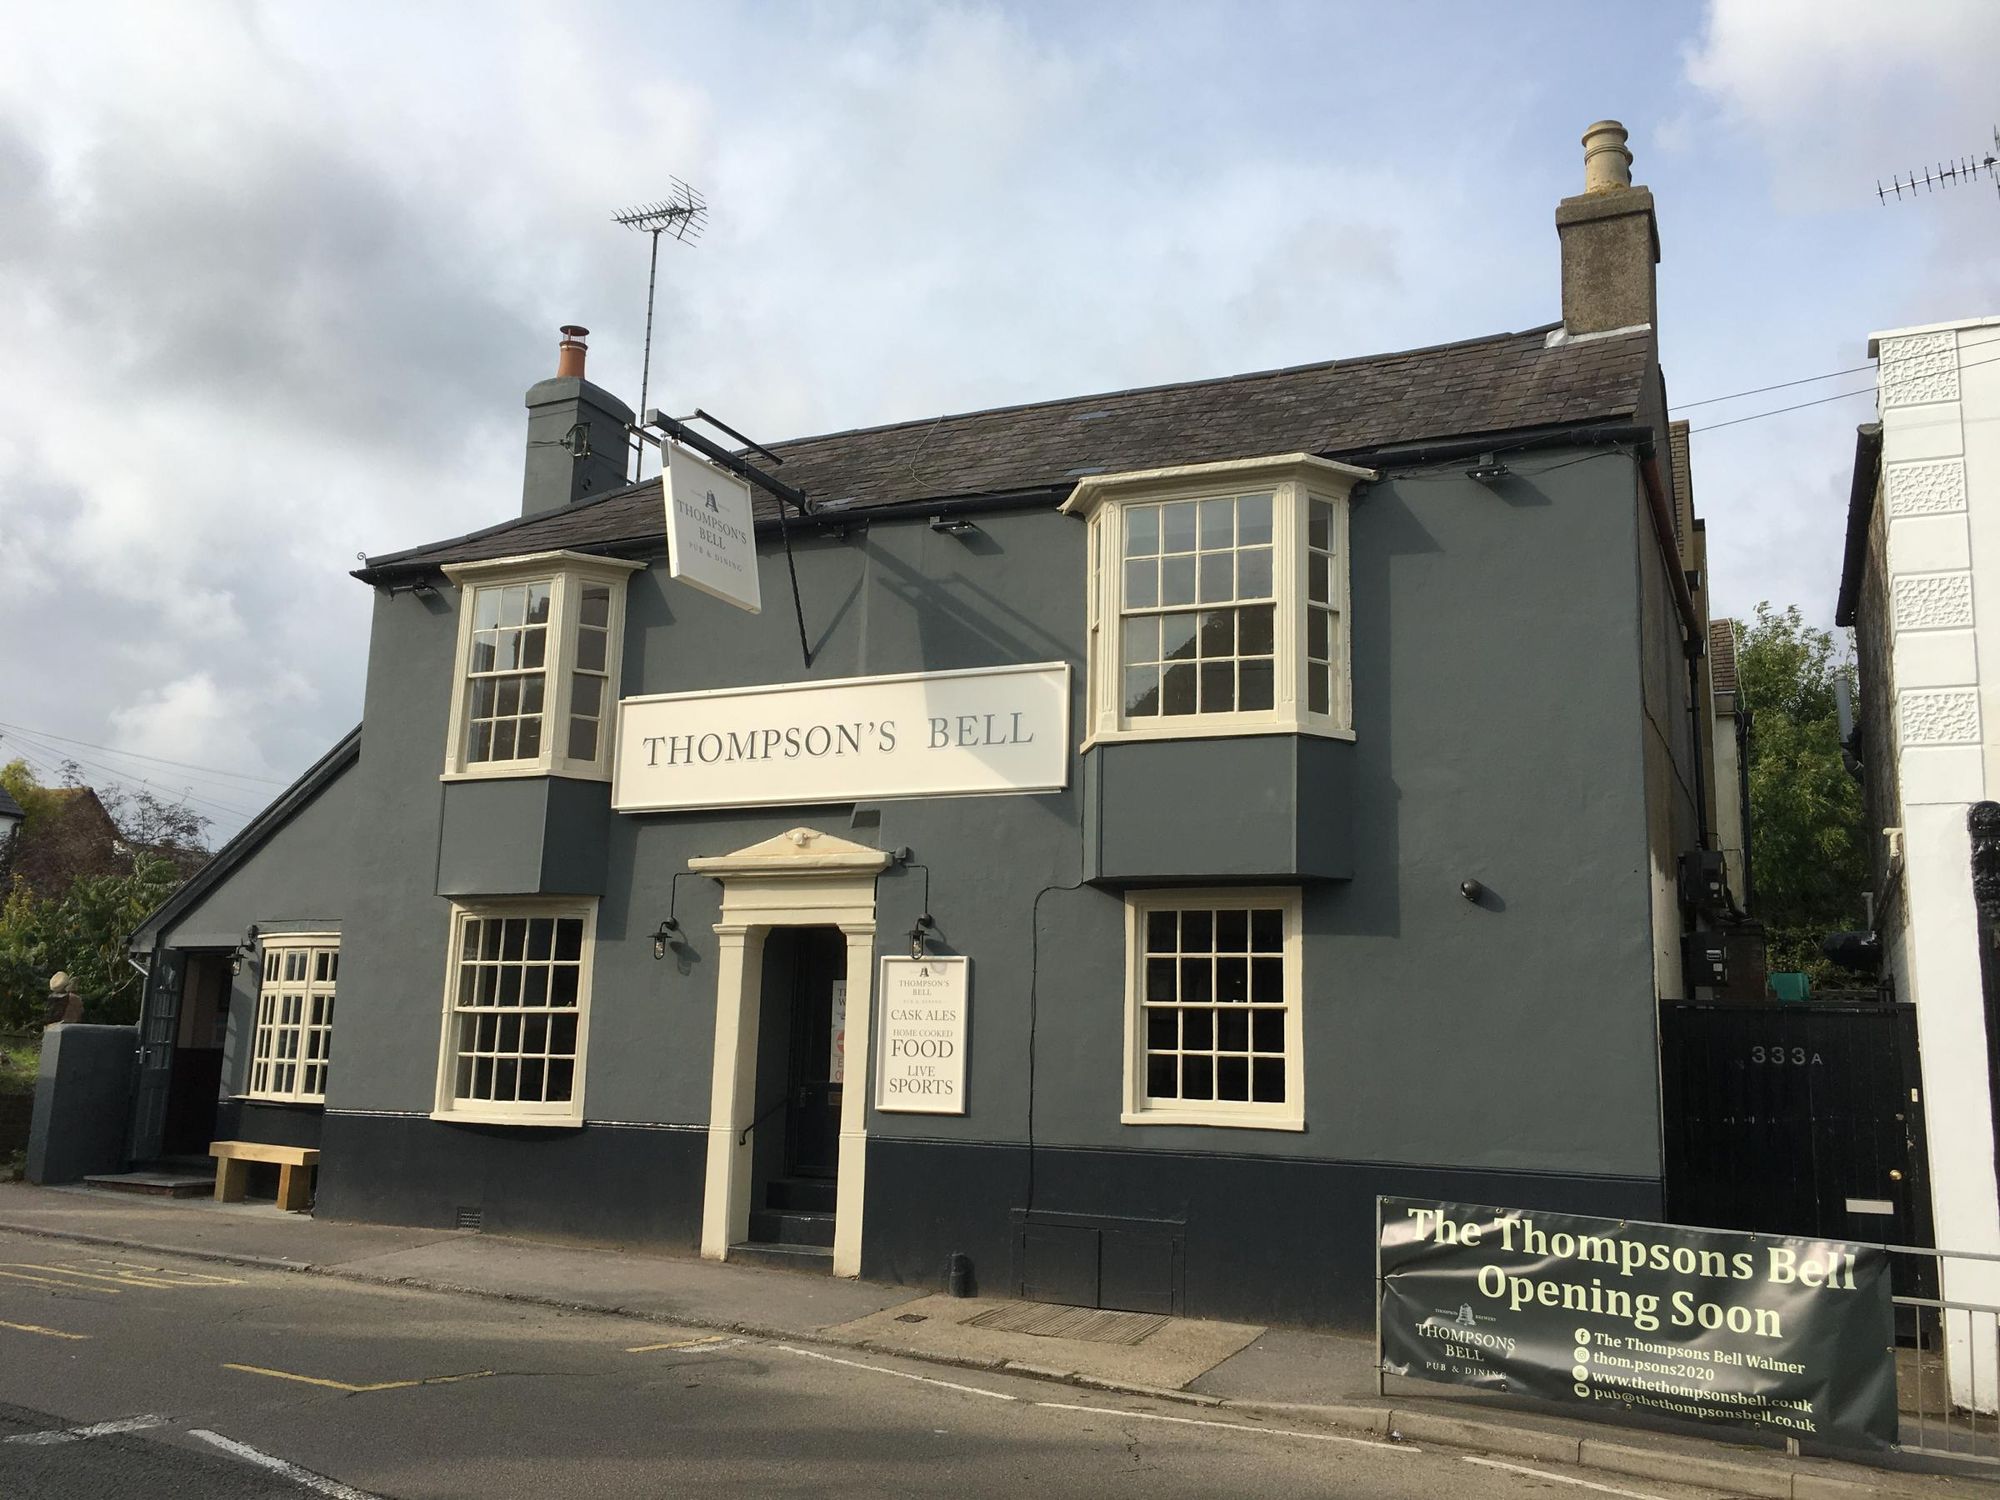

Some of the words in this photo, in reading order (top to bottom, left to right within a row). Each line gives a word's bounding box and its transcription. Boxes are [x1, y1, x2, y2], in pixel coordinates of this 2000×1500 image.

[676, 499, 747, 544] THOMPSON'S
[699, 527, 725, 550] BELL
[927, 712, 1034, 749] BELL
[891, 1009, 922, 1021] CASK
[925, 1010, 956, 1021] ALES
[893, 1029, 918, 1037] HOME
[919, 1029, 953, 1038] COOKED
[891, 1039, 954, 1058] FOOD
[908, 1065, 935, 1077] LIVE
[889, 1078, 953, 1095] SPORTS
[1408, 1207, 1482, 1247] The
[1494, 1216, 1753, 1279] Thompsons
[1767, 1247, 1858, 1290] Bell
[1477, 1265, 1660, 1331] Opening
[1671, 1290, 1784, 1338] Soon
[1415, 1323, 1516, 1351] THOMPSONS
[1445, 1344, 1484, 1362] BELL
[1593, 1351, 1715, 1382] thom.psons2020
[1594, 1332, 1622, 1348] The
[1625, 1336, 1710, 1363] Thompsons
[1714, 1350, 1742, 1367] Bell
[1746, 1354, 1806, 1375] Walmer
[1426, 1361, 1446, 1371] PUB
[1452, 1365, 1459, 1373] &
[1465, 1367, 1507, 1380] DINING
[1592, 1371, 1813, 1414] www.thethompsonsbell.co.uk
[1594, 1387, 1817, 1433] pub@thethompsonsbell.co.uk
